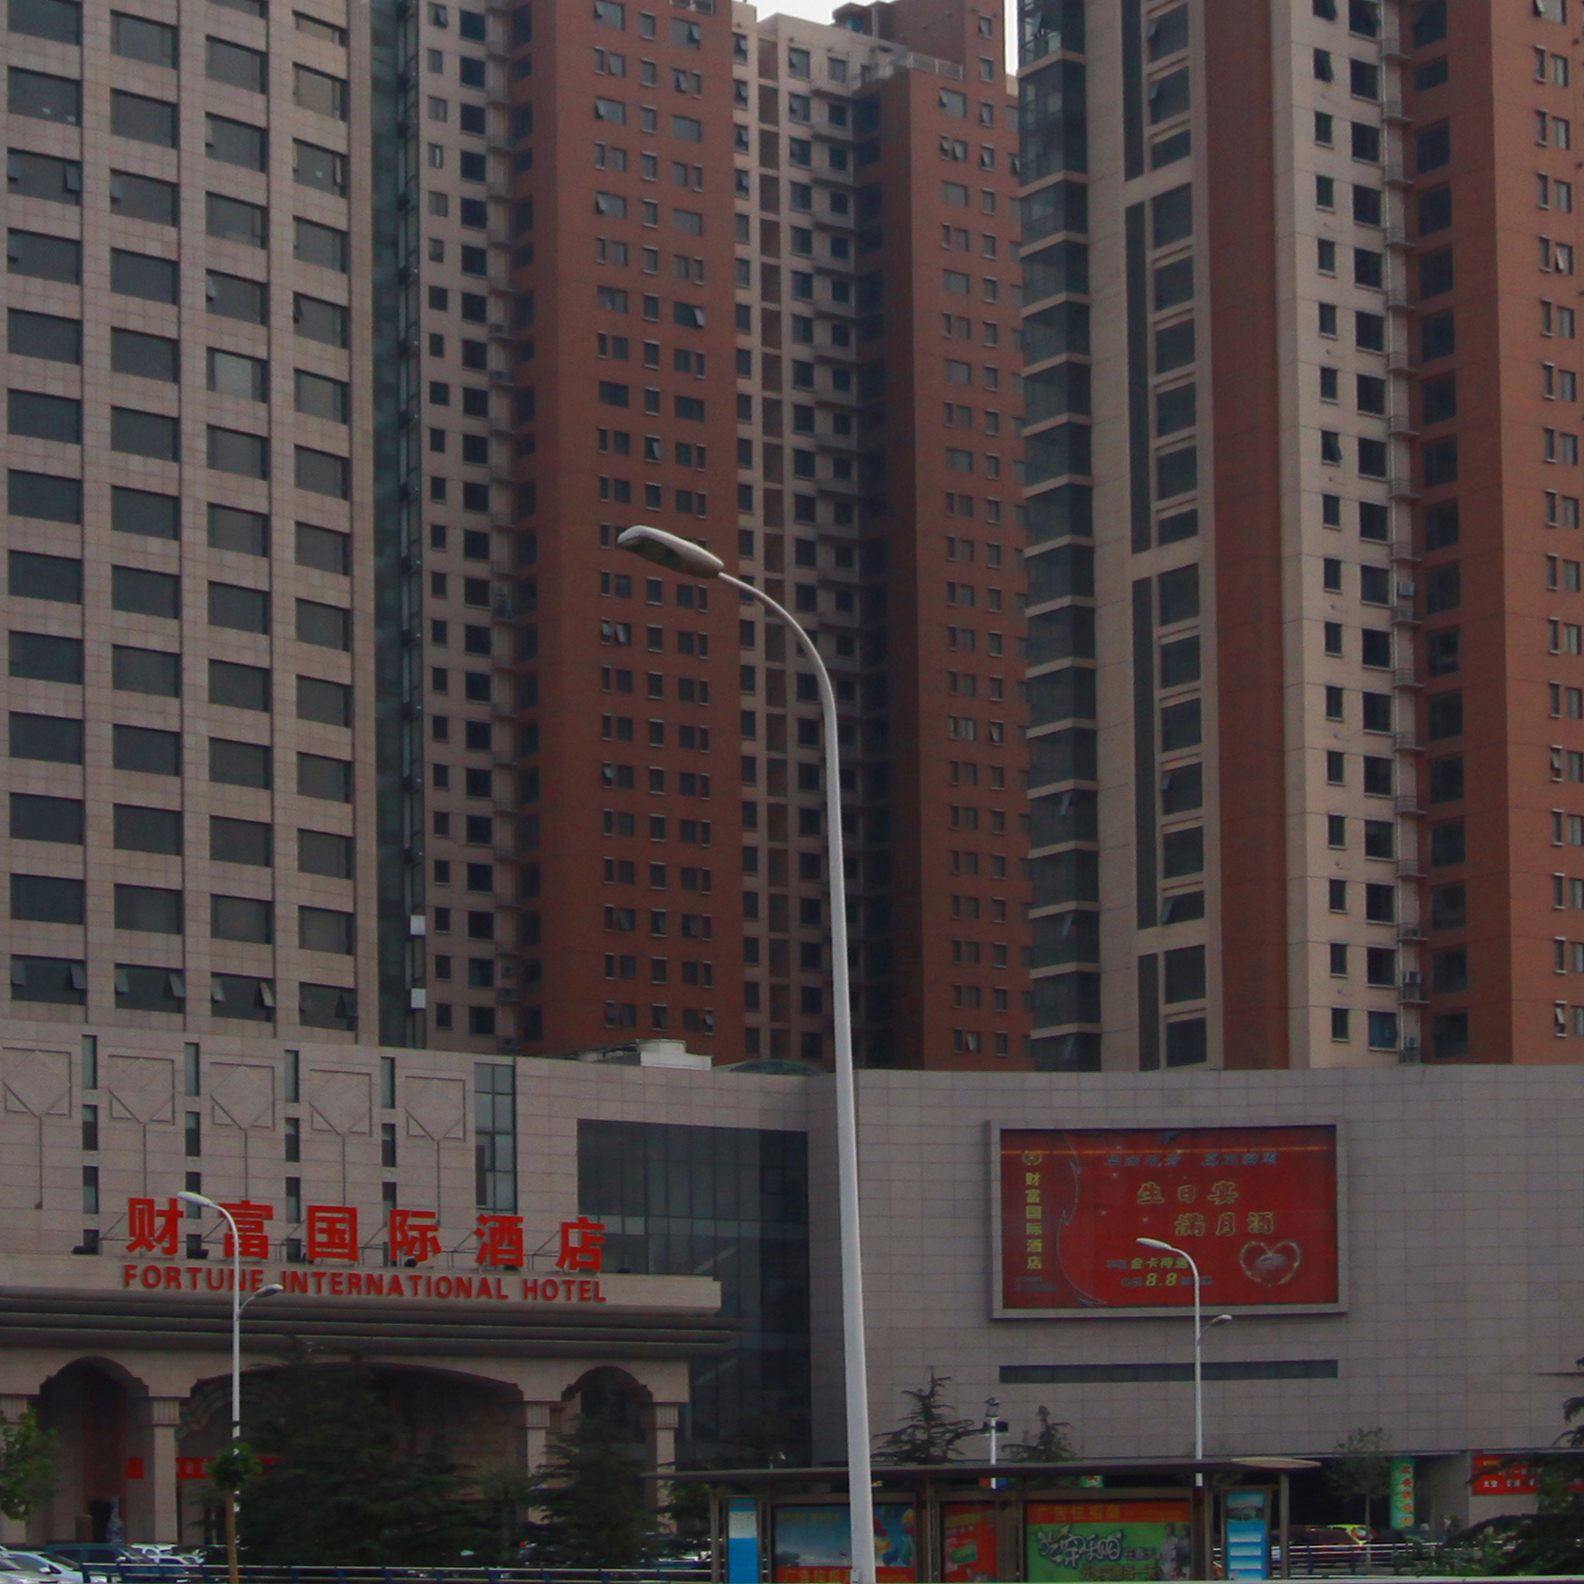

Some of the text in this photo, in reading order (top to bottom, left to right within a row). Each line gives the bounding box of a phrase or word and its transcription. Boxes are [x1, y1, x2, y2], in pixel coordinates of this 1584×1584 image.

[125, 1198, 606, 1272] 财富国际酒店
[1025, 1172, 1043, 1270] 财富国际酒店
[123, 1264, 607, 1303] FORTUNE INTERNATIONAL HOTEL
